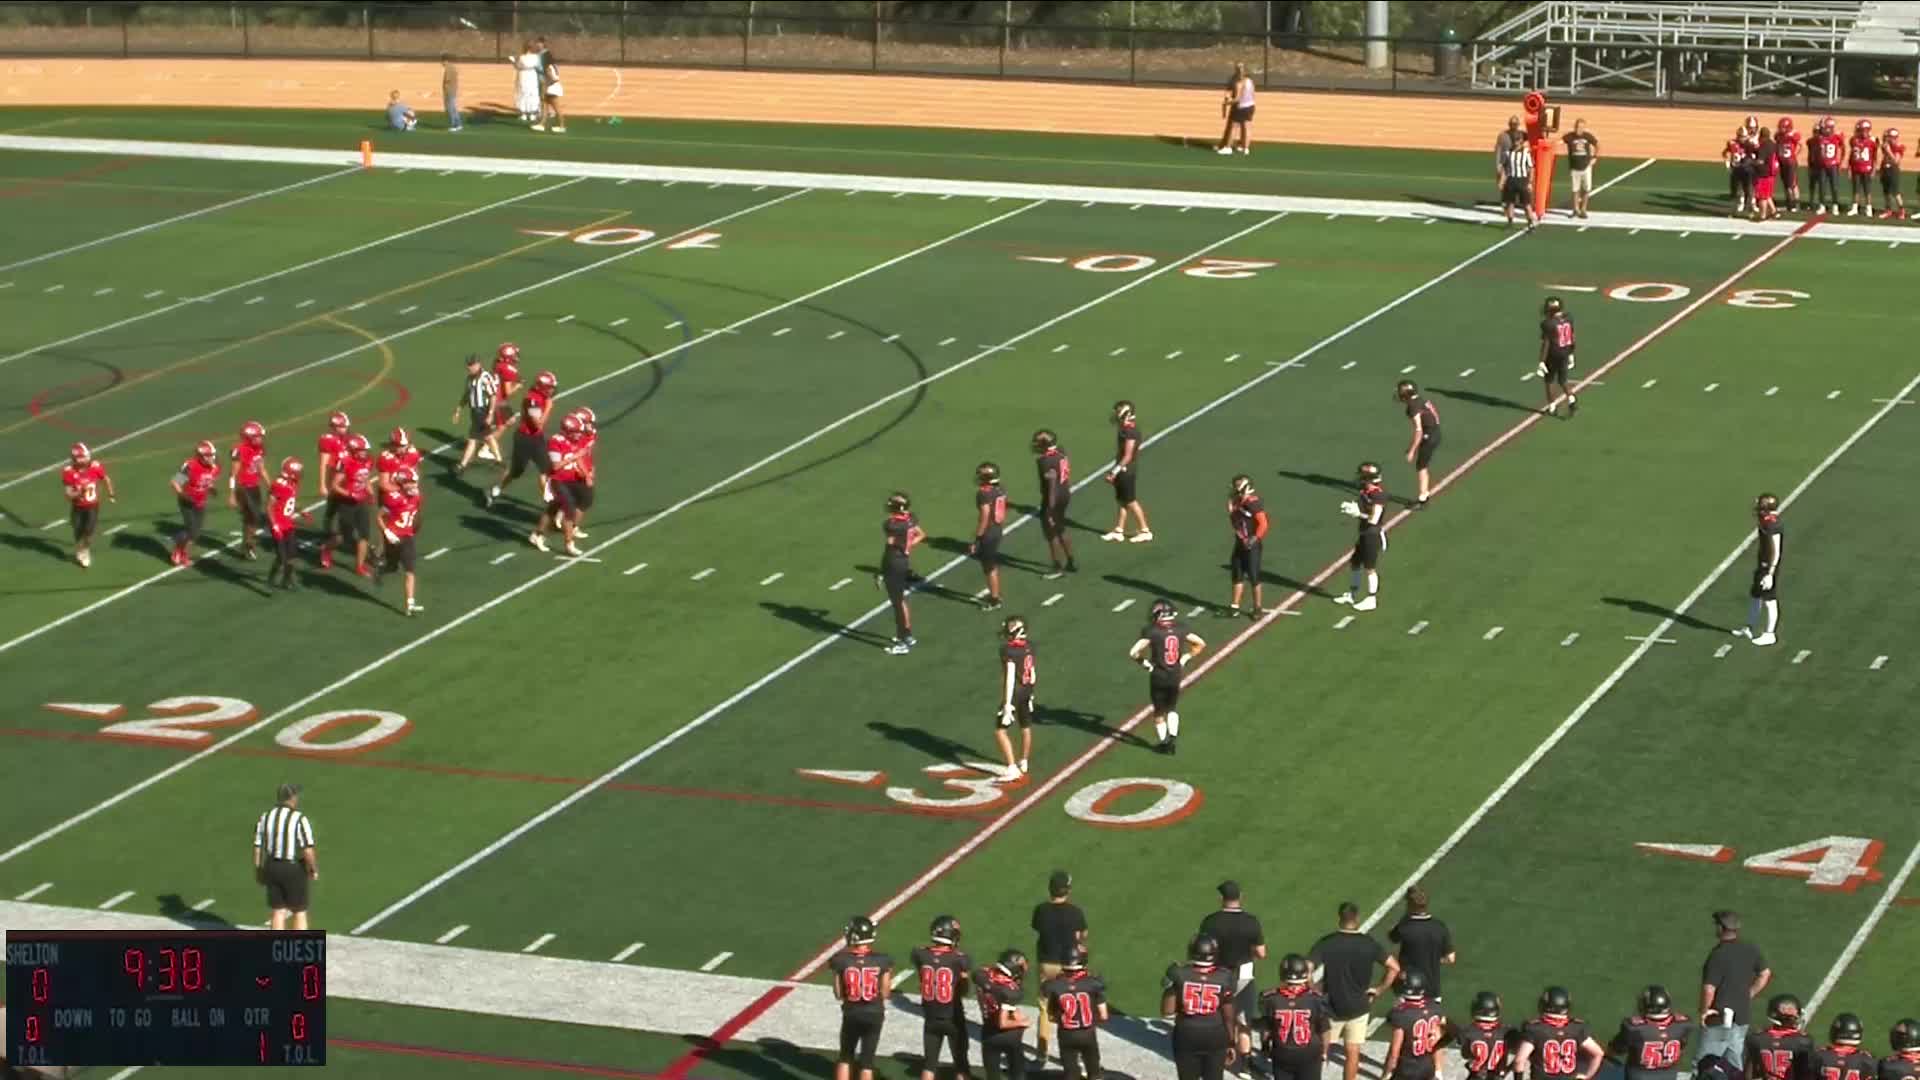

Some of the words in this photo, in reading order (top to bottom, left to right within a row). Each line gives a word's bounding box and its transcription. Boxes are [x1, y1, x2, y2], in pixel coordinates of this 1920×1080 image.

[100, 696, 410, 752] 20
[886, 762, 1200, 826] 30
[1059, 991, 1093, 1029] 21
[1183, 982, 1222, 1015] 55
[1275, 1010, 1312, 1045] 75
[1543, 1039, 1577, 1074] 63
